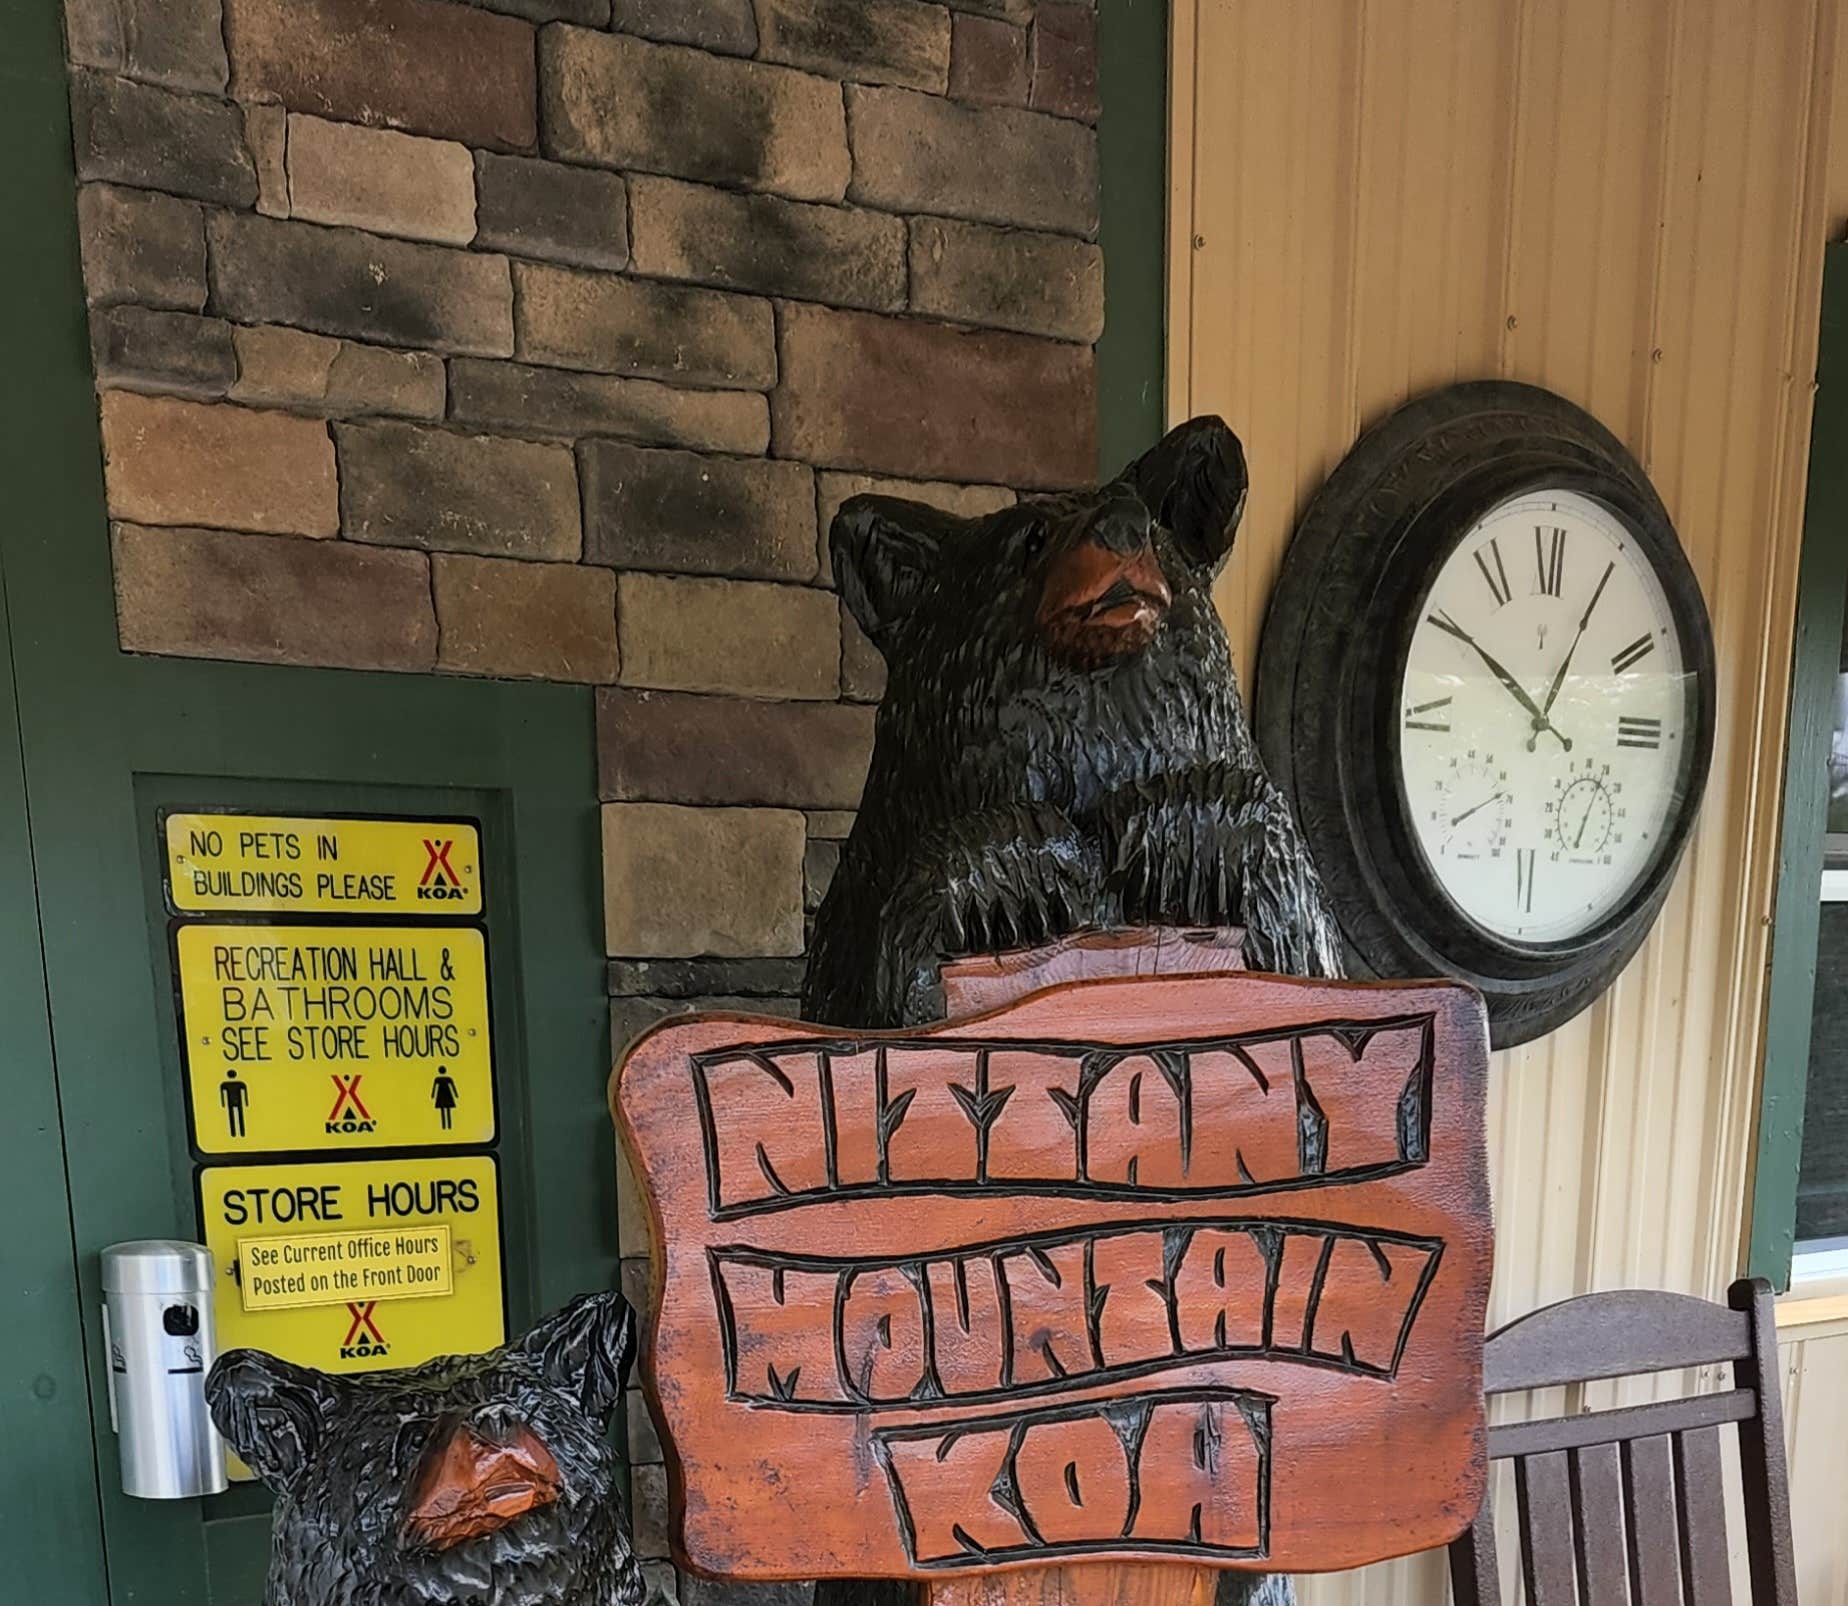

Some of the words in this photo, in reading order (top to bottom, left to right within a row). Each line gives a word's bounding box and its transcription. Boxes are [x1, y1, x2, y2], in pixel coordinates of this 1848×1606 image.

[1616, 715, 1662, 750] III
[190, 831, 223, 857] NO
[240, 833, 301, 860] PETS
[317, 836, 338, 861] IN
[194, 870, 303, 899] BUILDINGS
[318, 874, 397, 901] PLEASE
[214, 946, 357, 981] RECREATION
[369, 947, 427, 981] HALL
[440, 947, 455, 981] &
[222, 986, 454, 1021] BATHROOMS
[222, 1026, 272, 1061] SEE
[288, 1026, 369, 1060] STORE
[383, 1024, 460, 1058] HOURS
[689, 1010, 1437, 1222] NITTANY
[223, 1185, 343, 1225] STORE
[367, 1179, 480, 1217] HOURS
[252, 1244, 279, 1267] See
[283, 1240, 344, 1264] Current
[348, 1236, 391, 1259] Office
[396, 1235, 439, 1256] Hours
[253, 1272, 306, 1296] Posted
[311, 1275, 329, 1291] on
[333, 1269, 358, 1290] the
[363, 1266, 402, 1287] Front
[407, 1264, 440, 1284] Door
[705, 1215, 1444, 1412] MOUNTAIN
[870, 1386, 1279, 1570] KOA
